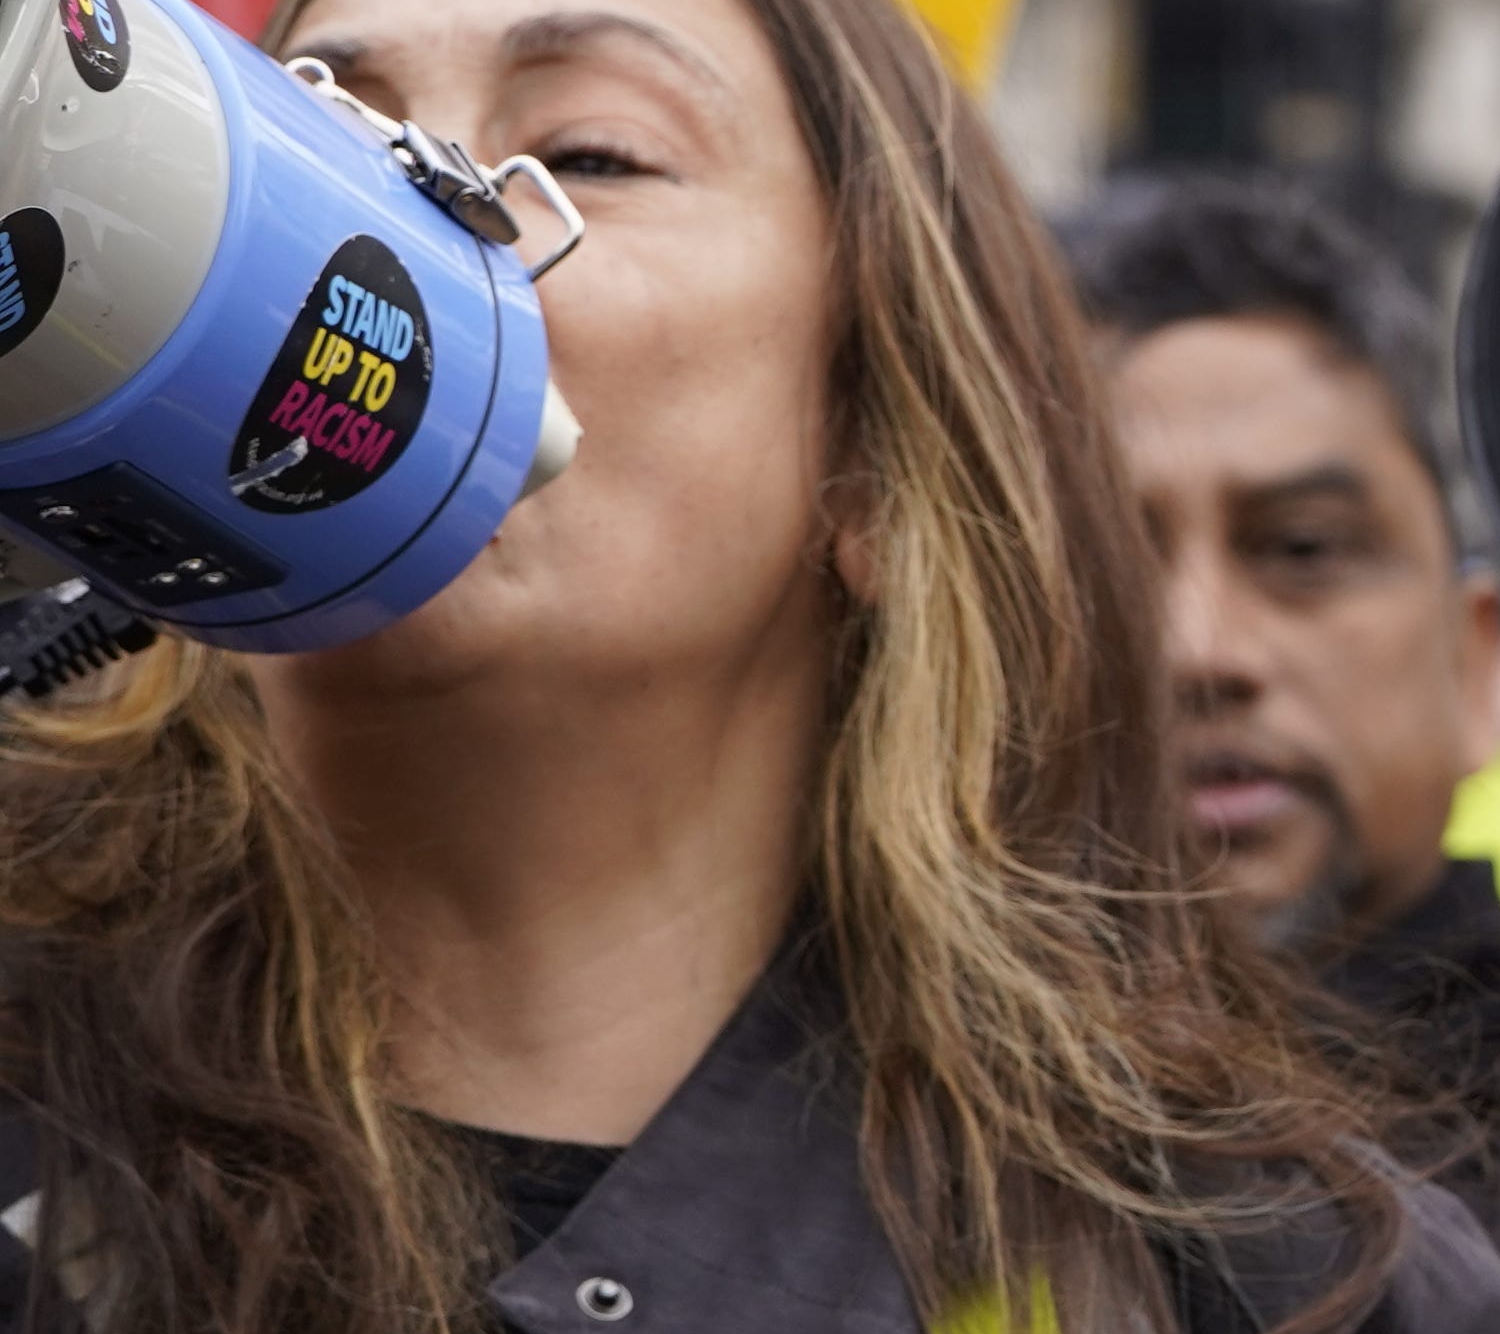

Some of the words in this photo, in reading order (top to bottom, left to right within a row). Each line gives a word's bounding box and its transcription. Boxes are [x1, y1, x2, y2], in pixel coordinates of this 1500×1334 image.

[322, 274, 415, 362] STAND
[302, 326, 354, 386] UP
[348, 350, 397, 413] TO
[267, 379, 396, 473] RACISM
